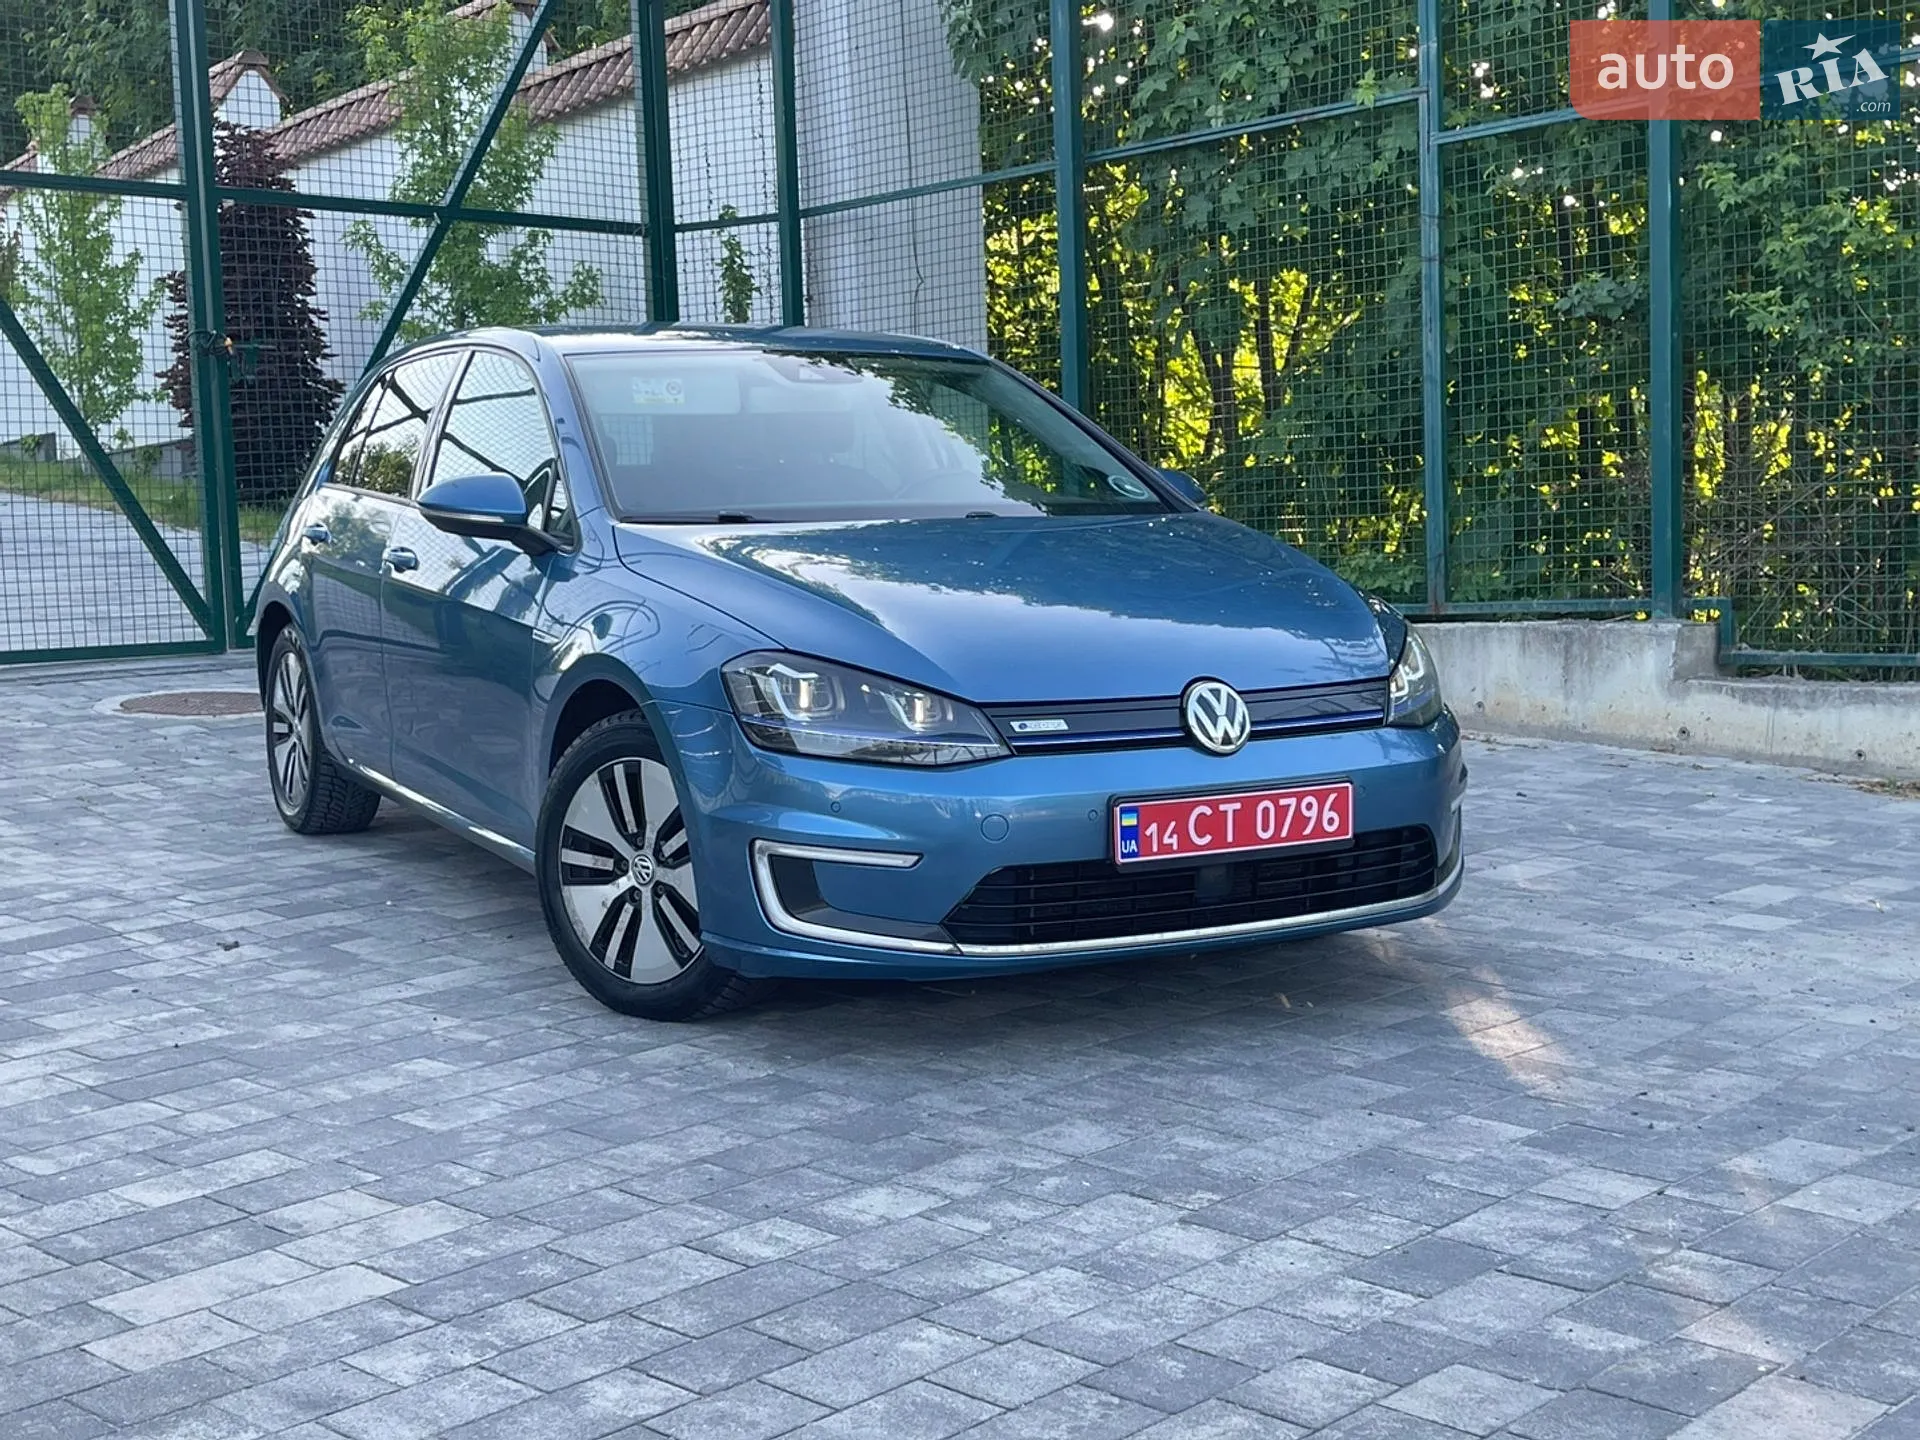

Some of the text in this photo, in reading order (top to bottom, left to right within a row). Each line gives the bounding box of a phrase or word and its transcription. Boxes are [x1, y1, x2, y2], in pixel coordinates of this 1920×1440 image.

[1187, 681, 1250, 752] VW
[1121, 840, 1138, 853] UA
[1144, 792, 1340, 853] 14 CT 0796
